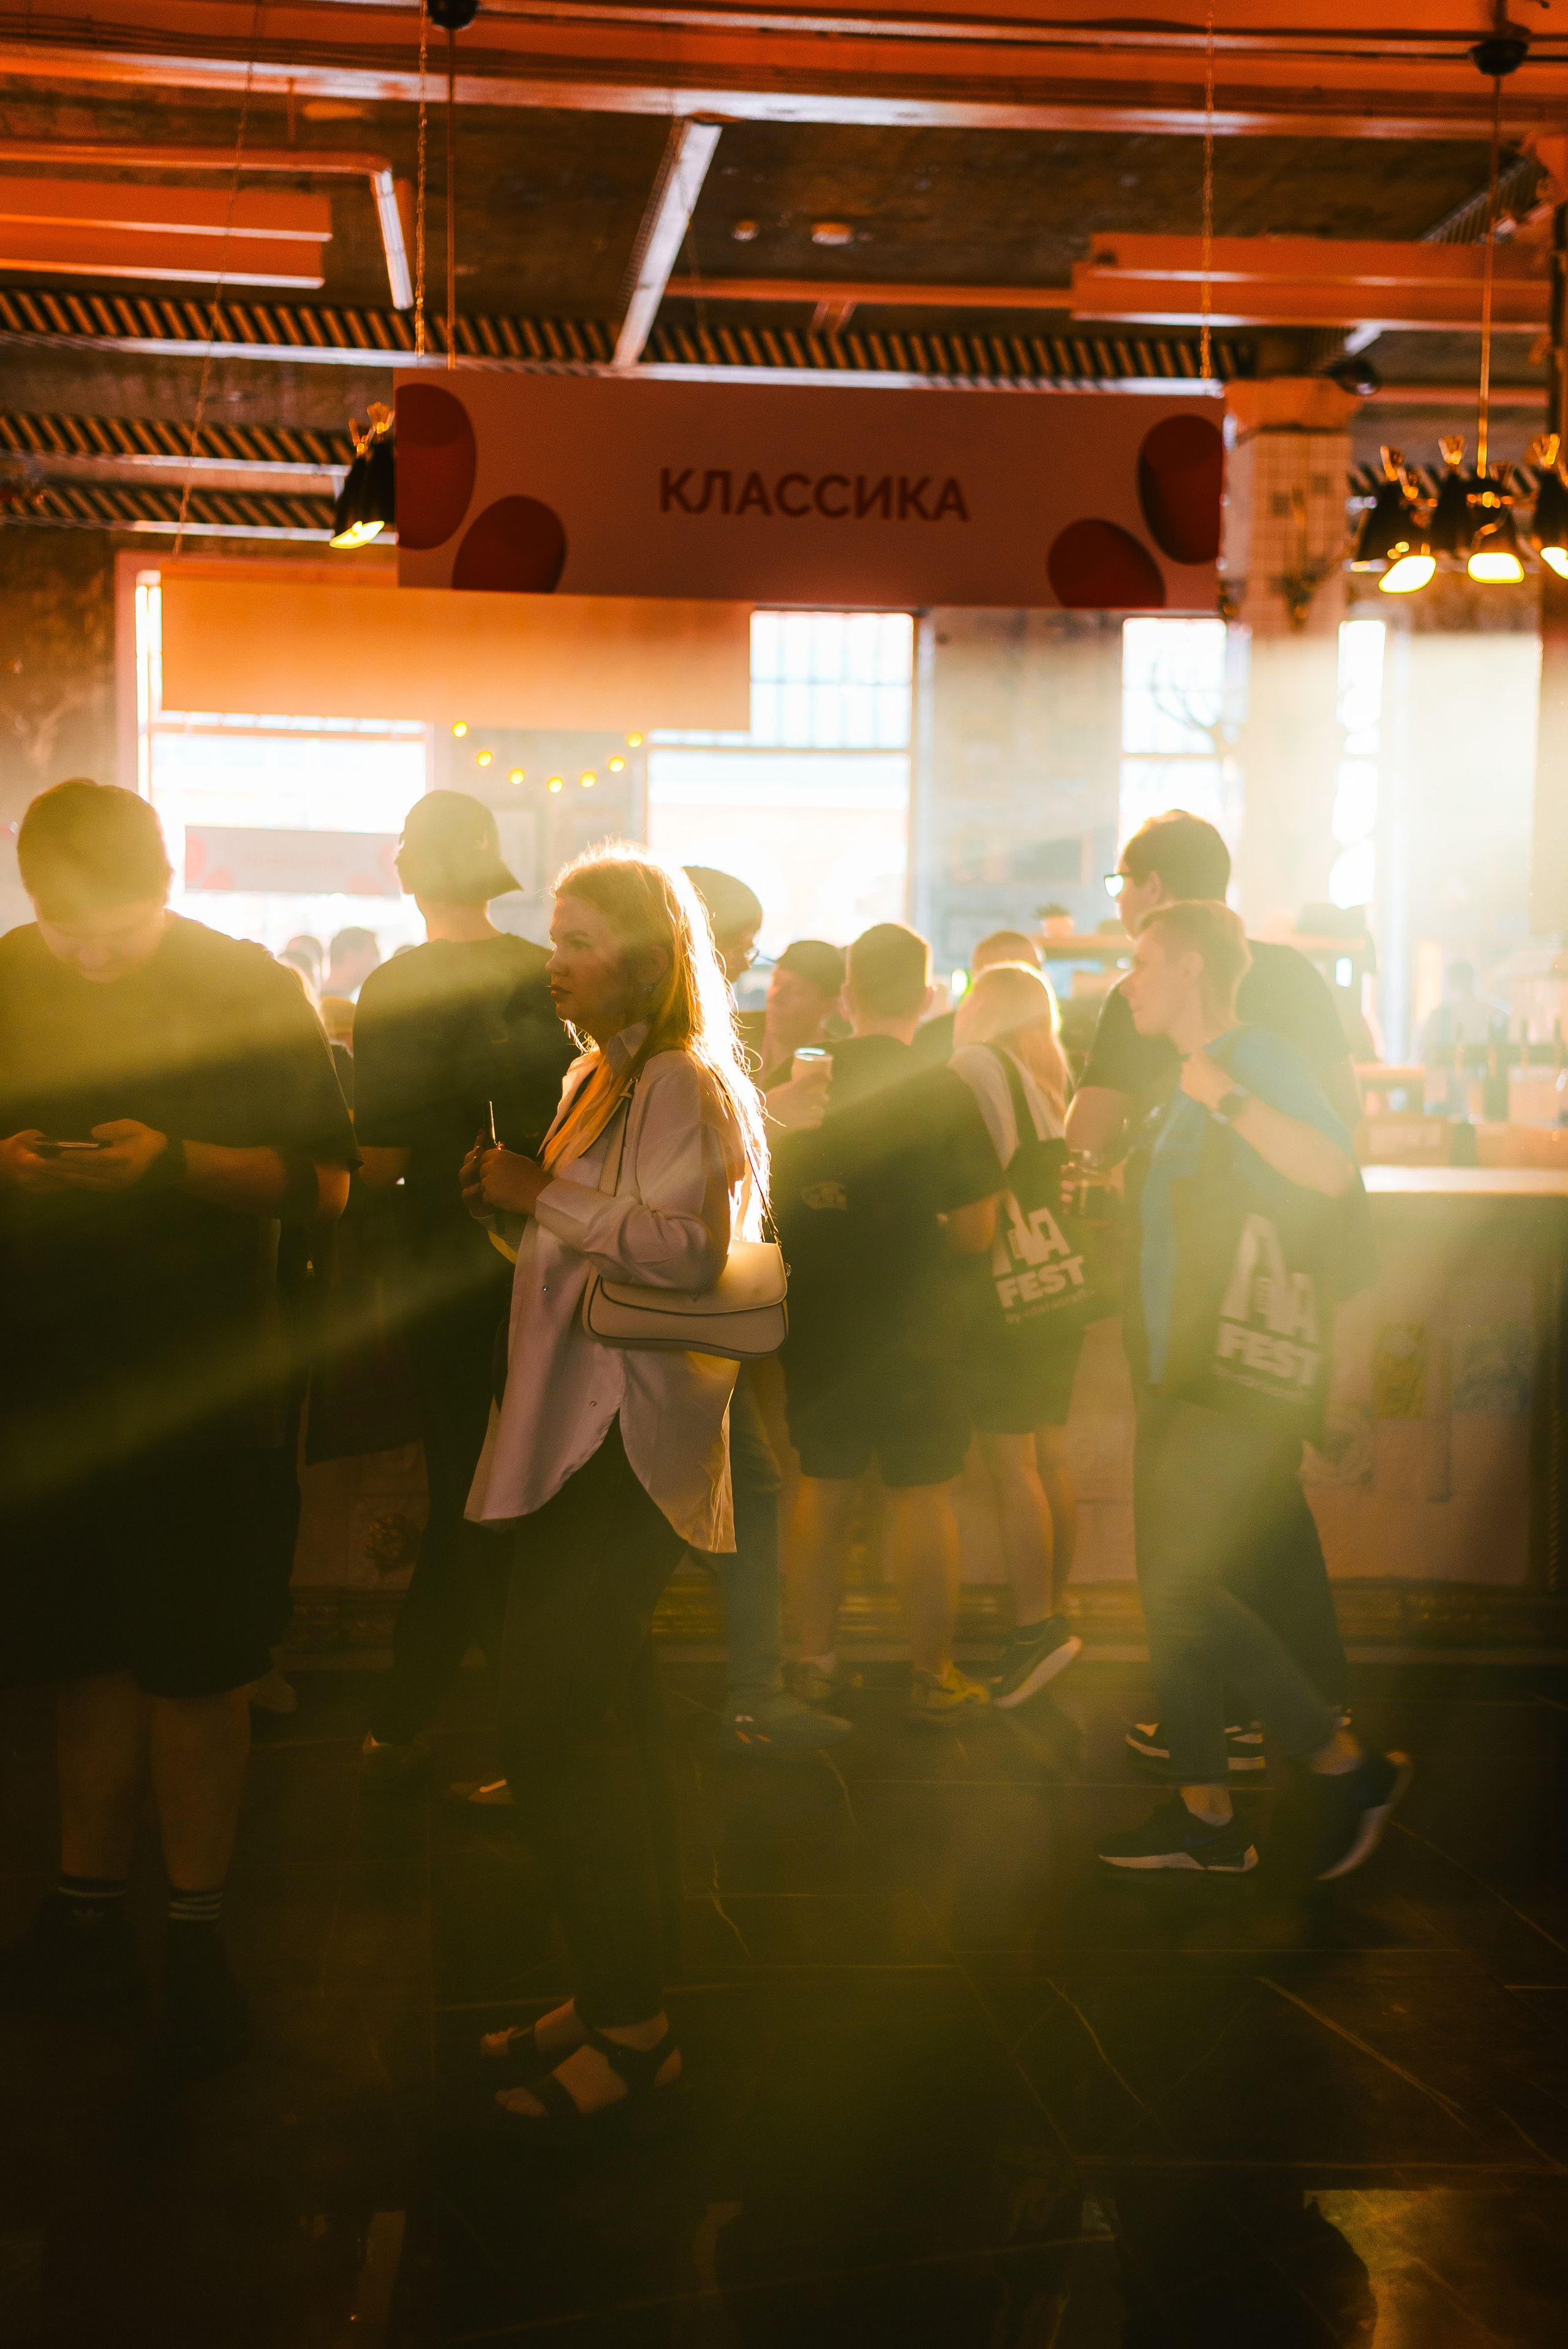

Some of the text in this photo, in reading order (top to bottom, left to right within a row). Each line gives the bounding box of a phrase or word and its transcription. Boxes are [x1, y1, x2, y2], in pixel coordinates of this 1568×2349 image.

[660, 467, 969, 521] КЛАССИКА
[995, 1255, 1084, 1308] FEST
[1215, 1321, 1322, 1386] FEST
